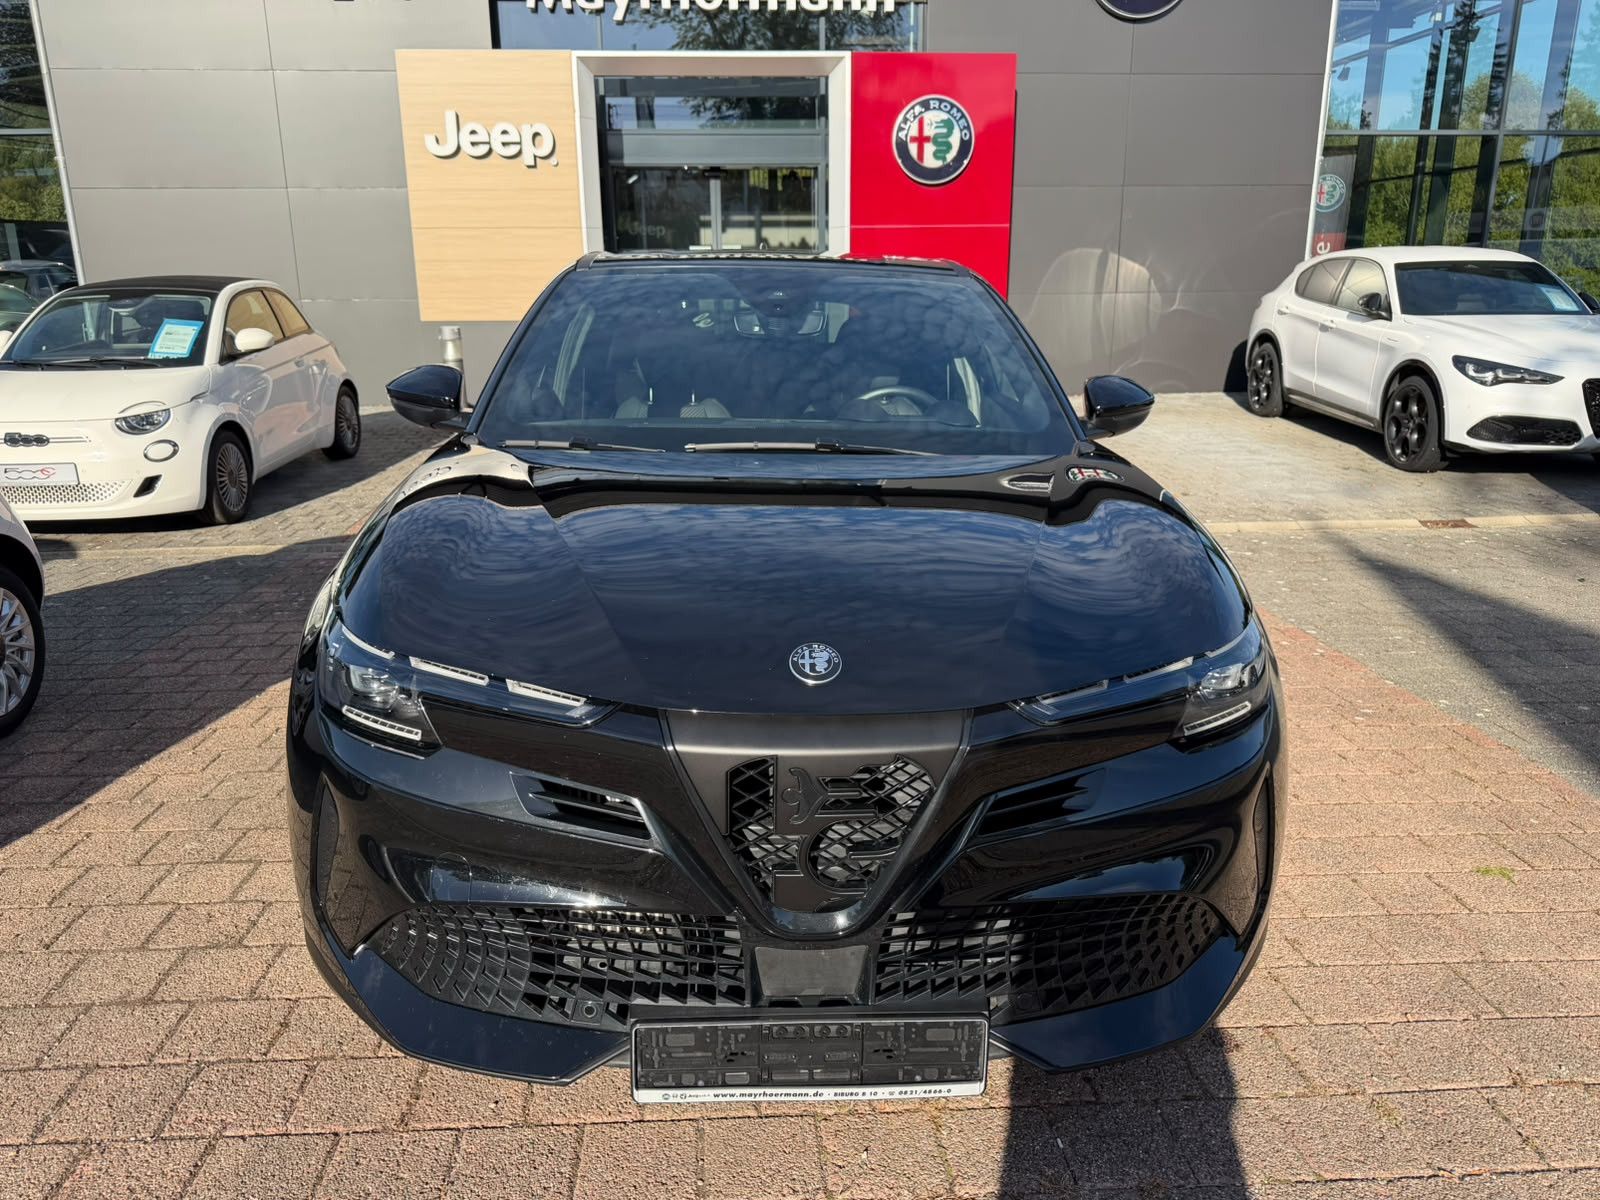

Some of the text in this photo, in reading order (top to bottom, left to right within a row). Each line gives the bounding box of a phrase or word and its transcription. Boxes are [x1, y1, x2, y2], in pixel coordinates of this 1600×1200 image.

[898, 100, 970, 141] ALFA ROMEO
[713, 1090, 824, 1099] www.mayrhoermann.de
